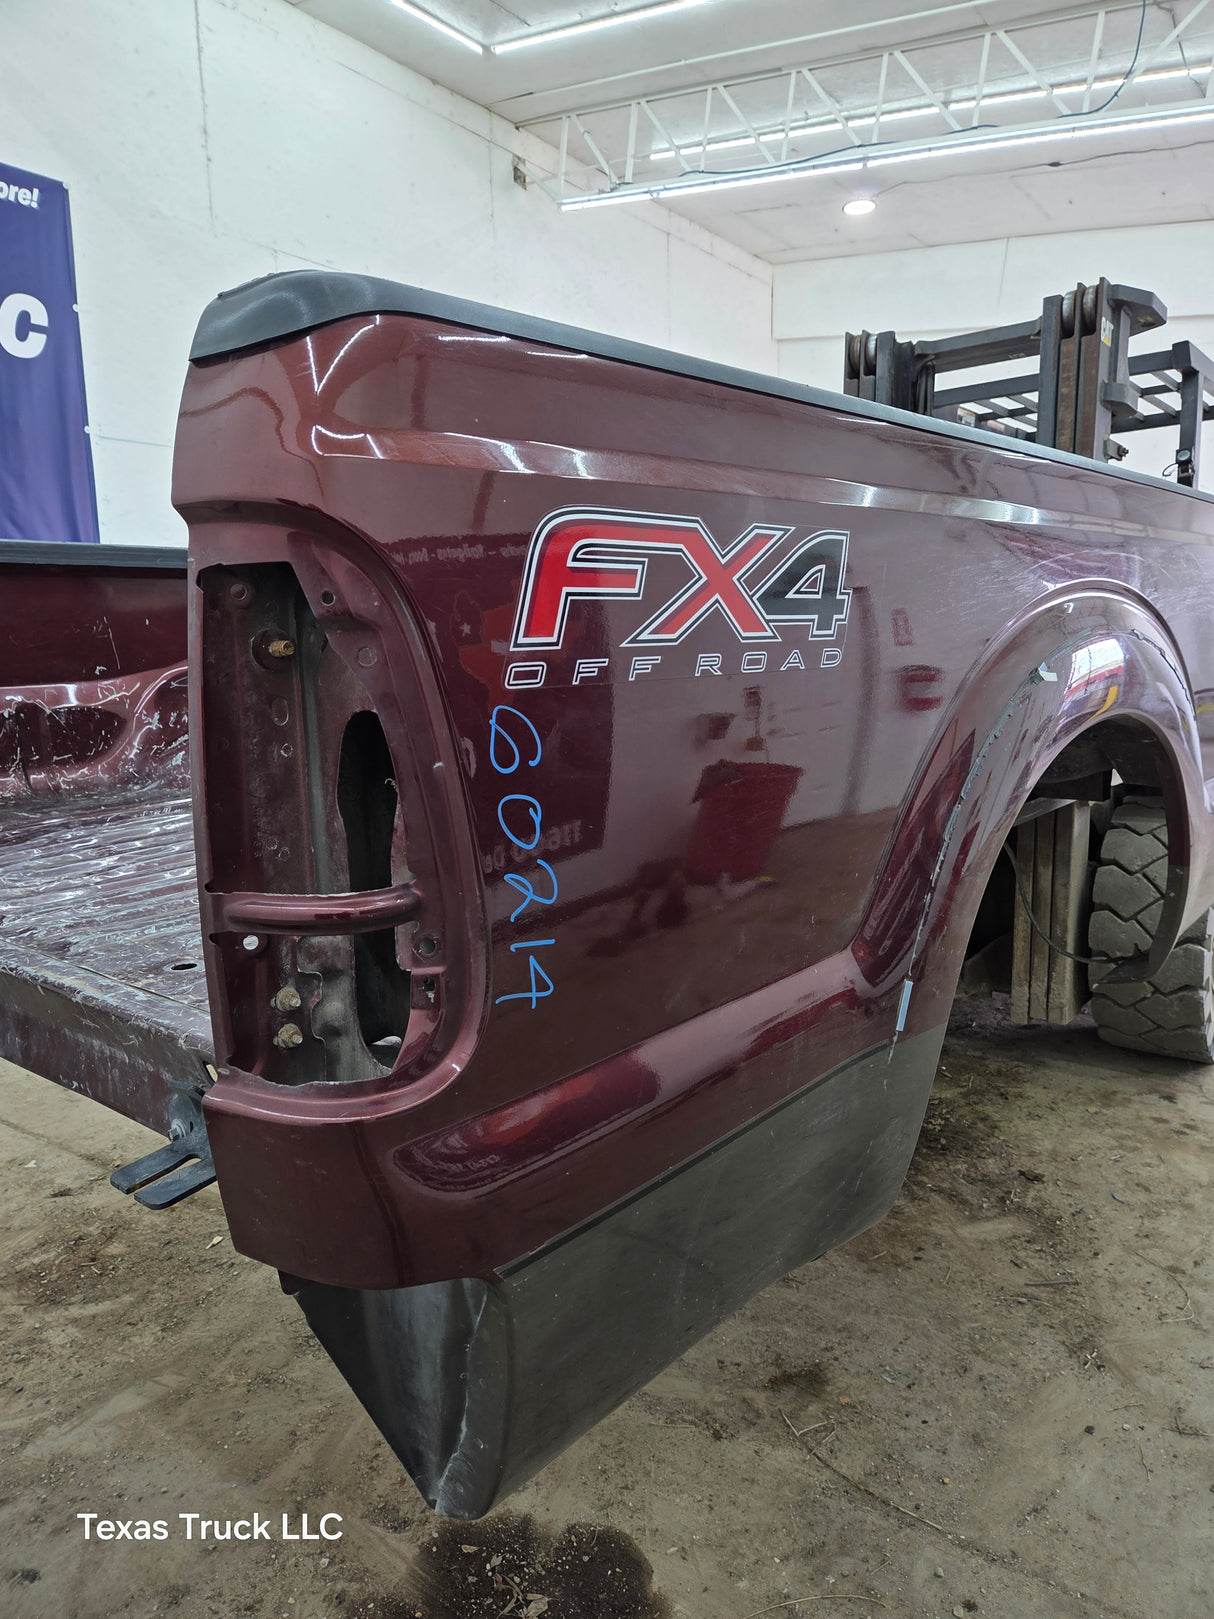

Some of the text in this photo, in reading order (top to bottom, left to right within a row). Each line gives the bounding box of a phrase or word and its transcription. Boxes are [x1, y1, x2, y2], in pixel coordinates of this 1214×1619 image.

[510, 504, 852, 651] FX4
[505, 648, 842, 690] OFF ROAD
[489, 705, 558, 1009] 60214
